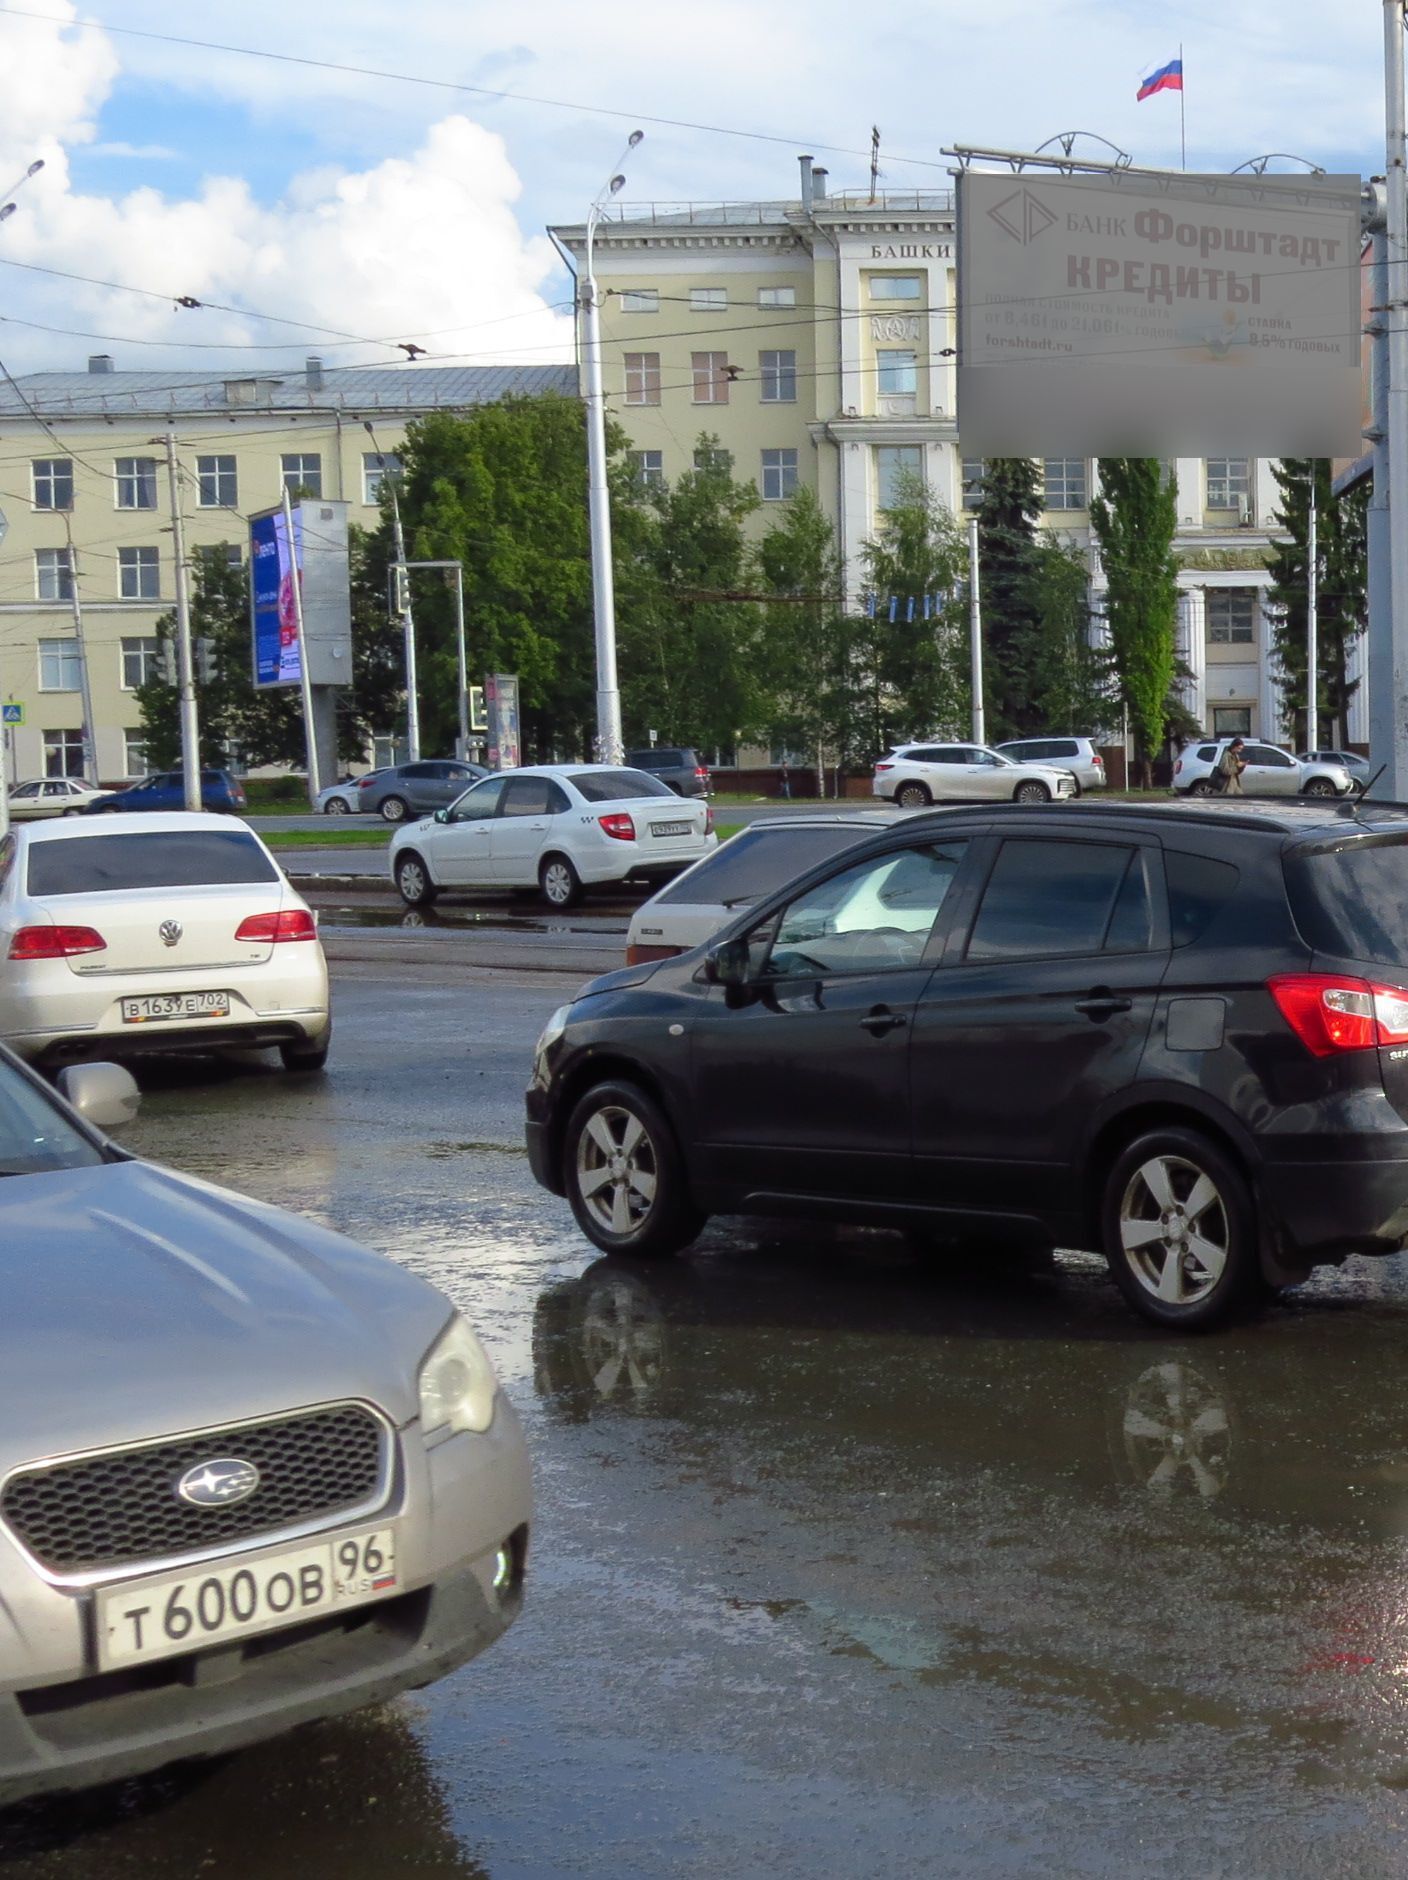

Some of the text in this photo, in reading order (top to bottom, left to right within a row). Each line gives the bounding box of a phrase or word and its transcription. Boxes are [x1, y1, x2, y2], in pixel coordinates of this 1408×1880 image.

[1066, 208, 1341, 267] БАНК Форштадт
[1067, 254, 1261, 305] КРЕДИТЫ
[985, 333, 1073, 352] forshtadt.ru
[198, 993, 223, 1006] 702
[124, 1535, 383, 1649] Т600ОВ 96
